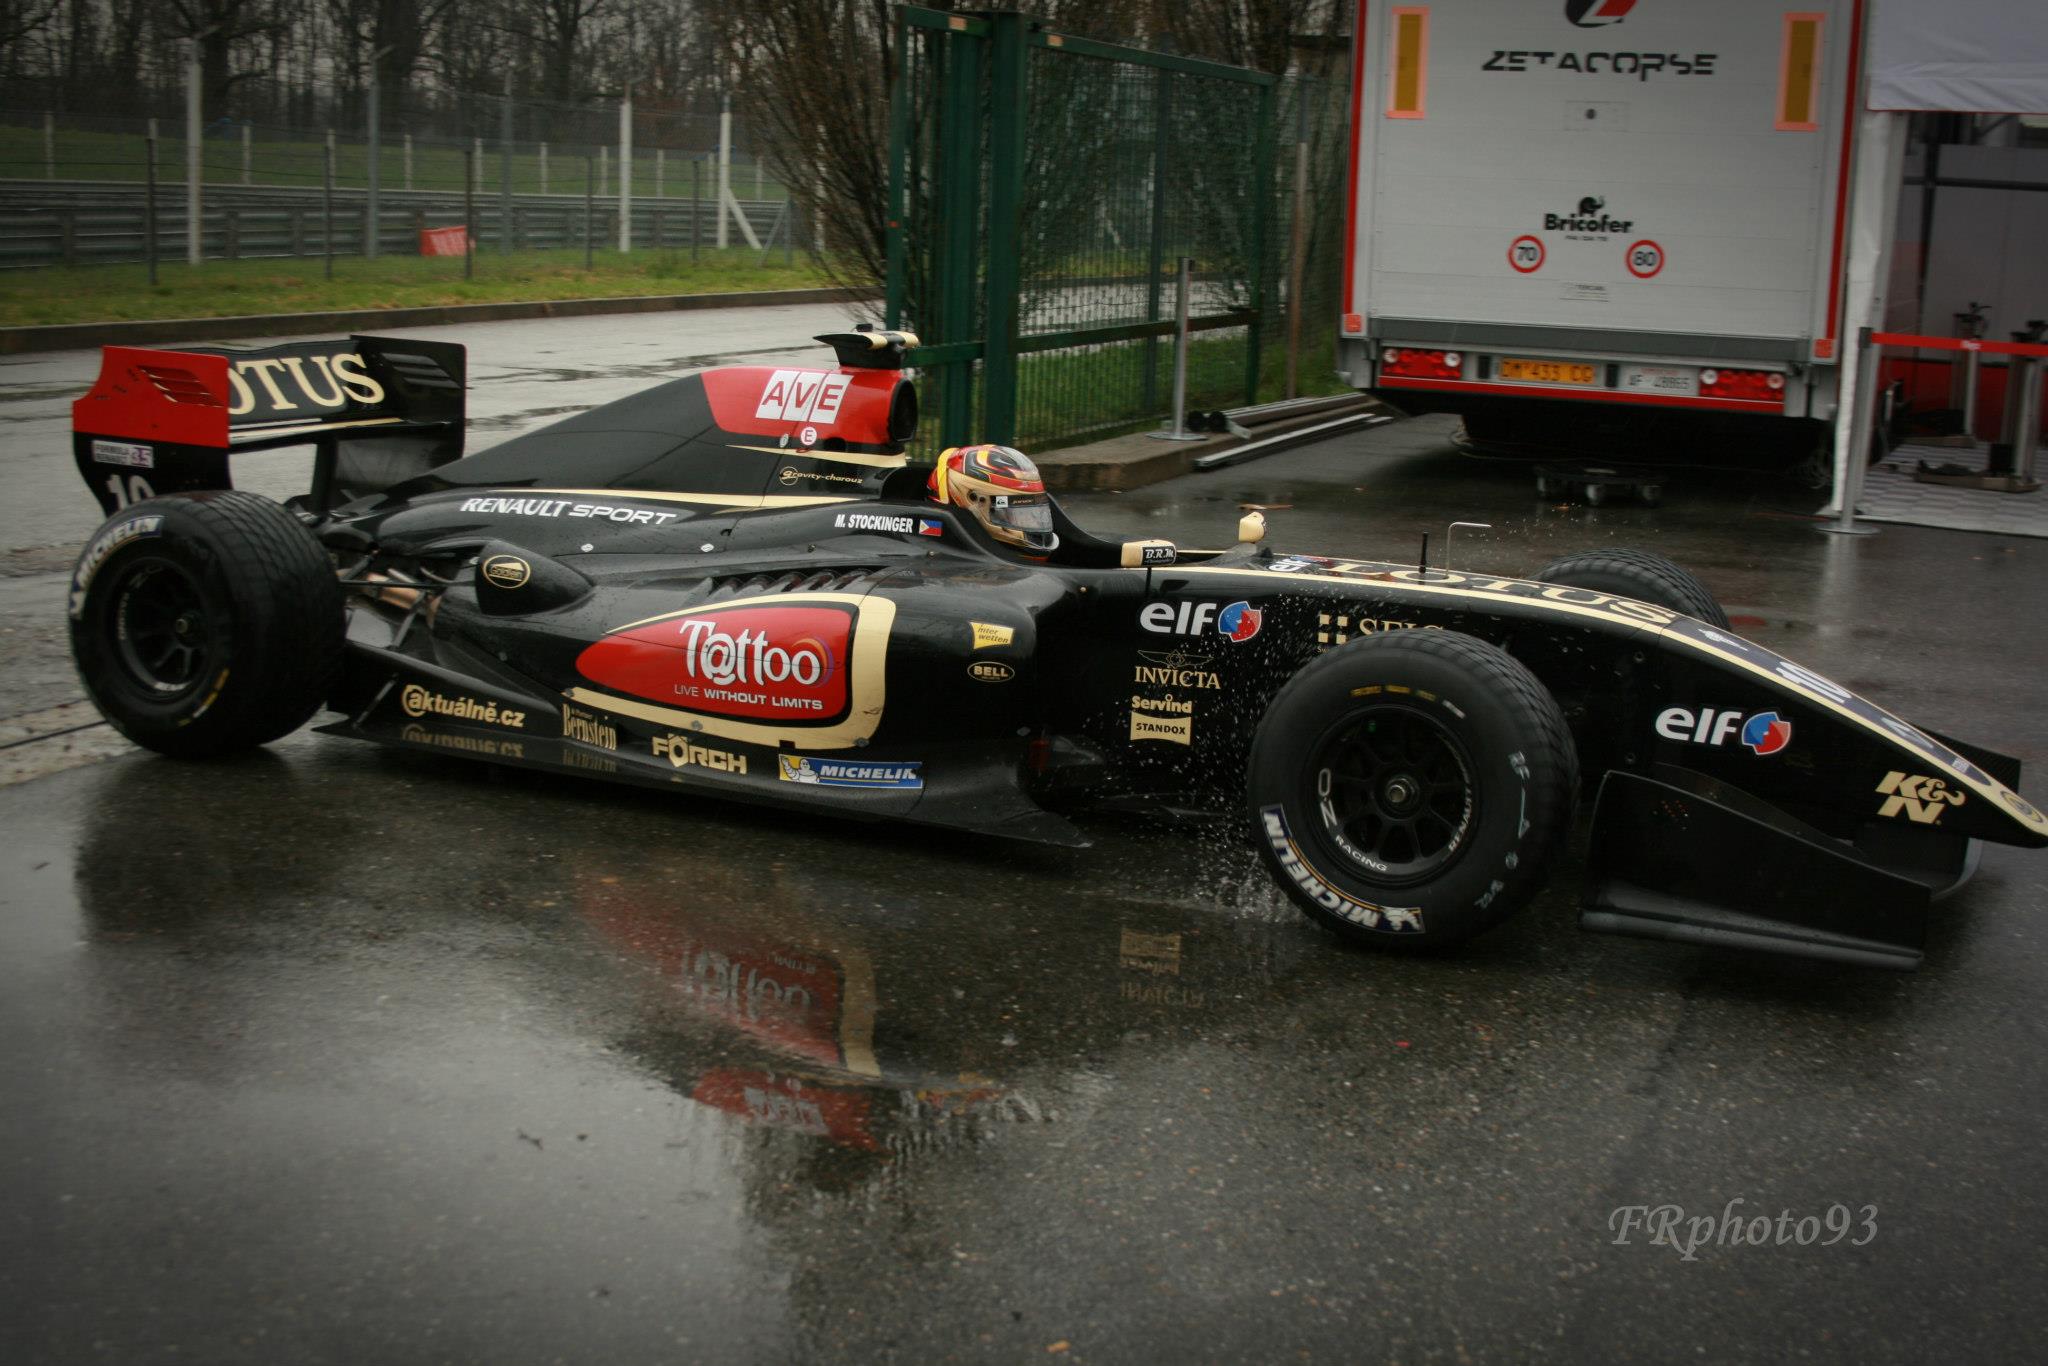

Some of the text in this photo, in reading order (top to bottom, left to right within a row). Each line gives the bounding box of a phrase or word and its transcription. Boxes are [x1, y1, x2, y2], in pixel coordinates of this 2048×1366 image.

[1482, 51, 1718, 82] ZETACORSE
[1544, 214, 1634, 233] Bricofer
[1517, 246, 1538, 261] 70
[1633, 251, 1656, 267] 80
[762, 380, 844, 411] AVE
[780, 469, 864, 484] gravity-charouz
[459, 498, 677, 525] RENAULT SPORT
[834, 514, 914, 533] M. STOCKINGER
[1320, 562, 1678, 625] LOTUS
[1140, 601, 1217, 636] elf
[978, 633, 1009, 644] wetten
[680, 620, 821, 685] T@ttoo
[974, 665, 1009, 678] BELL
[1135, 666, 1221, 690] INVICTA
[674, 684, 823, 710] LIVE WITHOUT LIMITS
[1131, 693, 1193, 714] Servind
[563, 703, 617, 751] Bernstein
[1136, 722, 1186, 736] STANDOX
[1655, 707, 1743, 746] elf
[652, 733, 748, 774] FÖRCH
[820, 765, 917, 779] MICHELIN
[1334, 833, 1388, 873] RACING
[1262, 811, 1382, 929] MICHELIN
